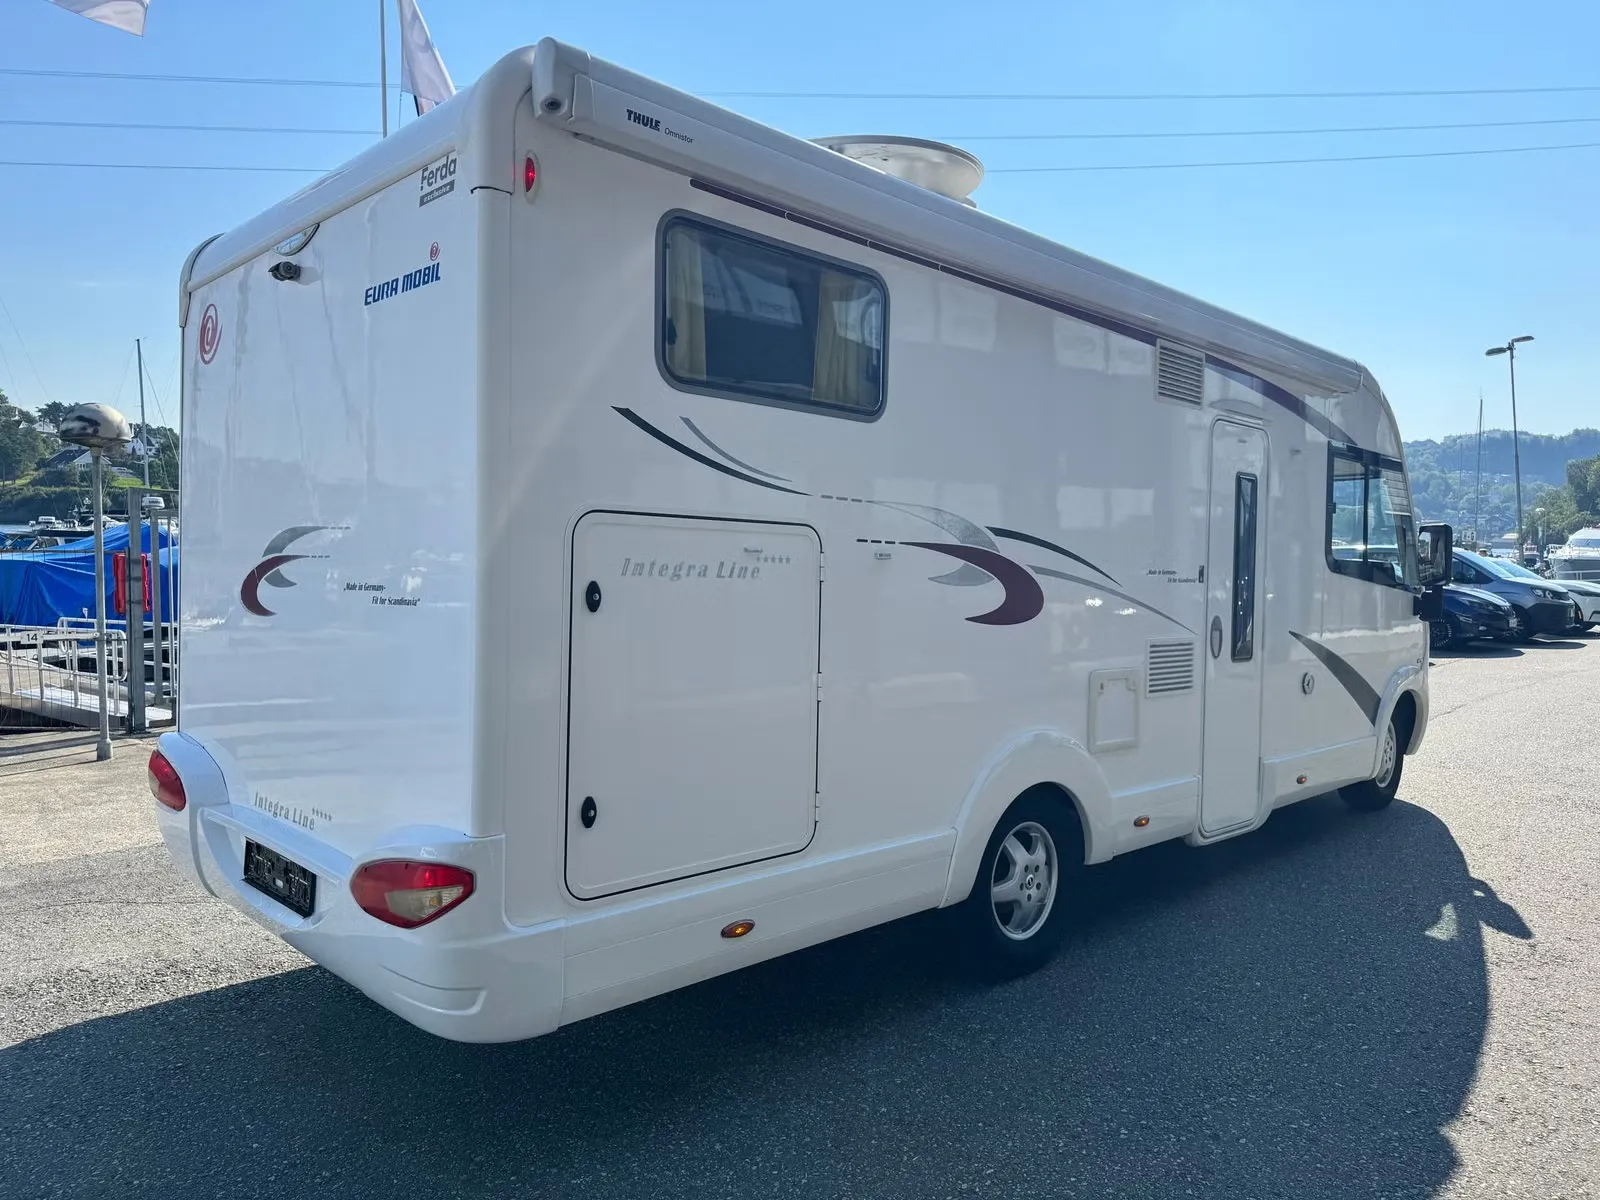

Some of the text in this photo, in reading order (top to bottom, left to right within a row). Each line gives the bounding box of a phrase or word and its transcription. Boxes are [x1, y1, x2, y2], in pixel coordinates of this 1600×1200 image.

[626, 109, 694, 144] THULE Omnistor
[420, 155, 457, 192] Ferda
[423, 184, 451, 203] exclusive
[364, 262, 441, 307] EURA MOBIL
[620, 557, 761, 582] Integra Line
[27, 633, 38, 642] 14
[254, 792, 315, 831] Integra Line
